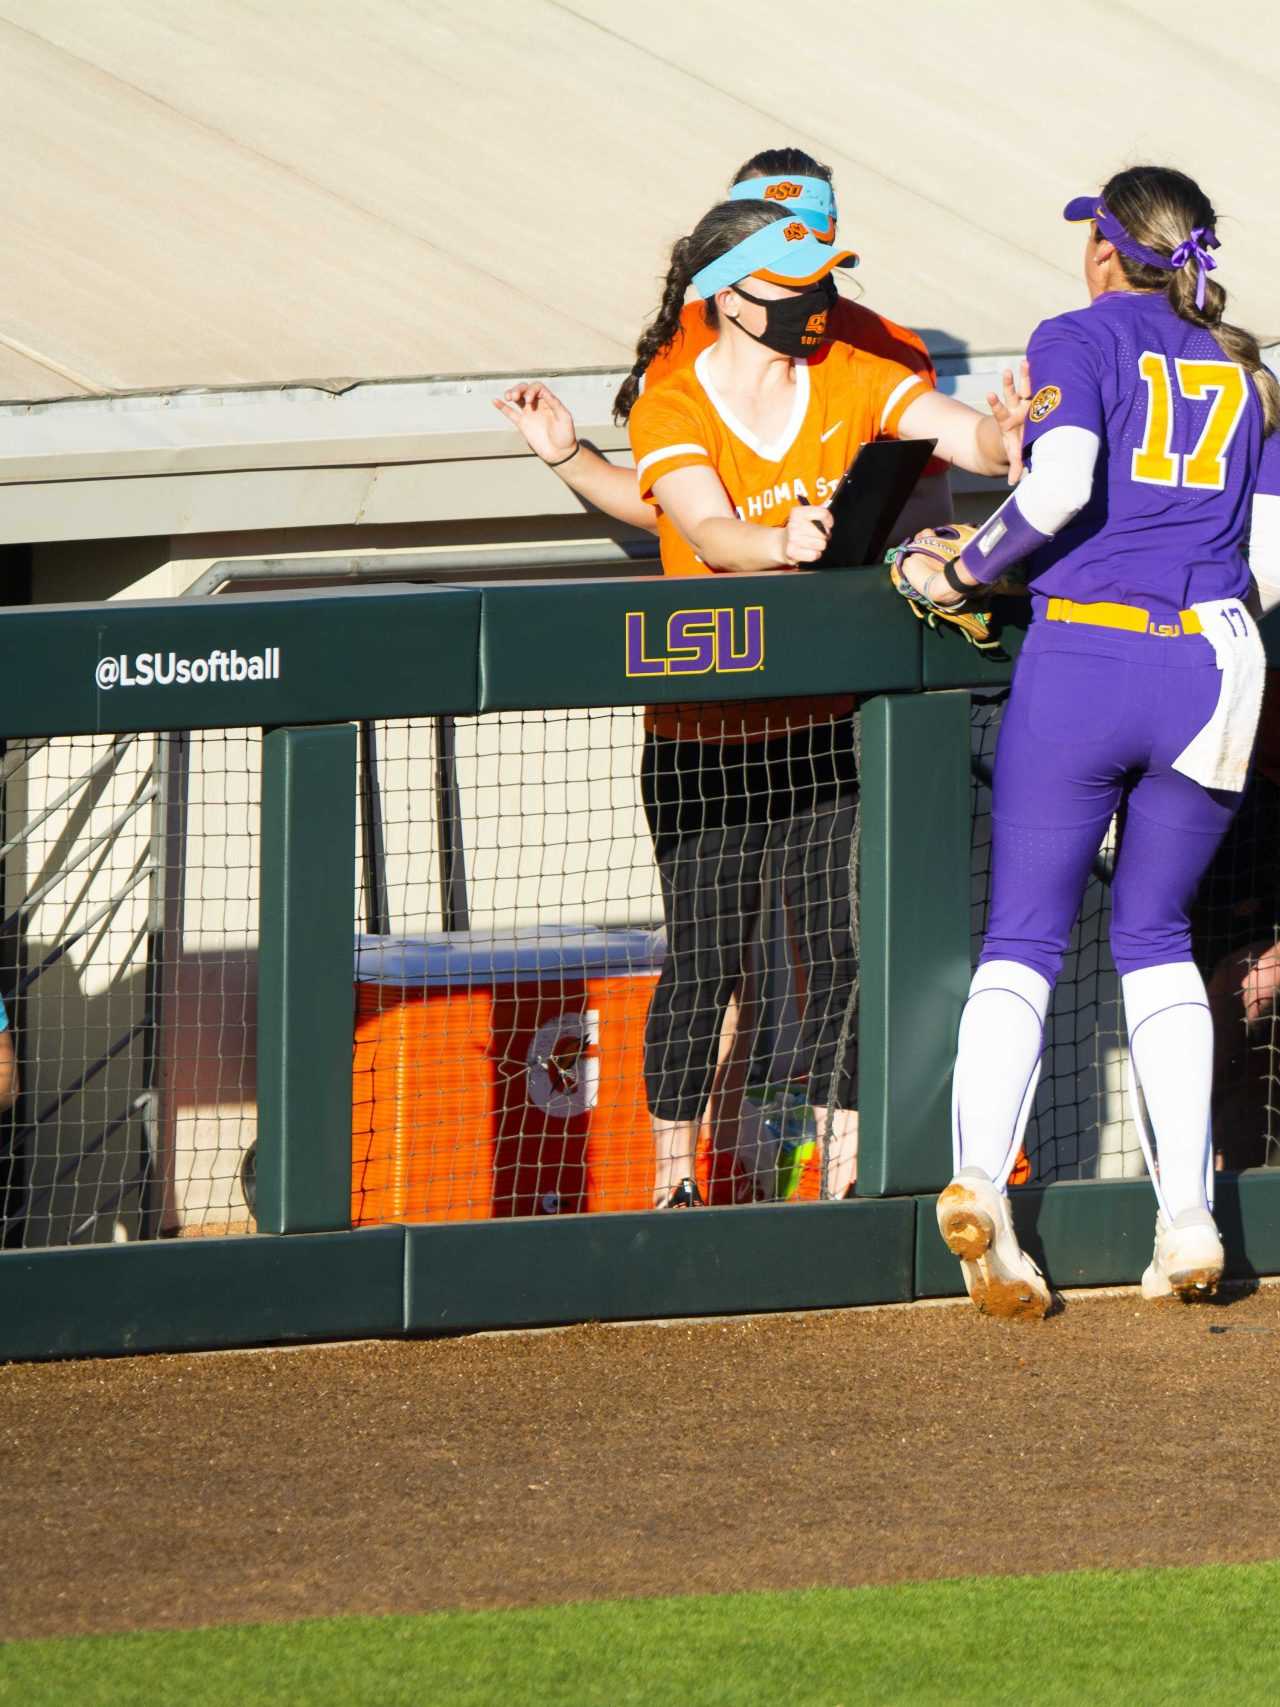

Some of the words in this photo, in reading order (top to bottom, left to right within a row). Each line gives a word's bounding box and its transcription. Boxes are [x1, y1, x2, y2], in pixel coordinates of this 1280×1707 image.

[764, 181, 803, 201] OSU
[1131, 350, 1248, 490] 17
[1149, 622, 1180, 638] LSU
[1220, 607, 1248, 637] 17
[625, 606, 765, 677] LSU
[95, 647, 280, 690] @LSUsoftball
